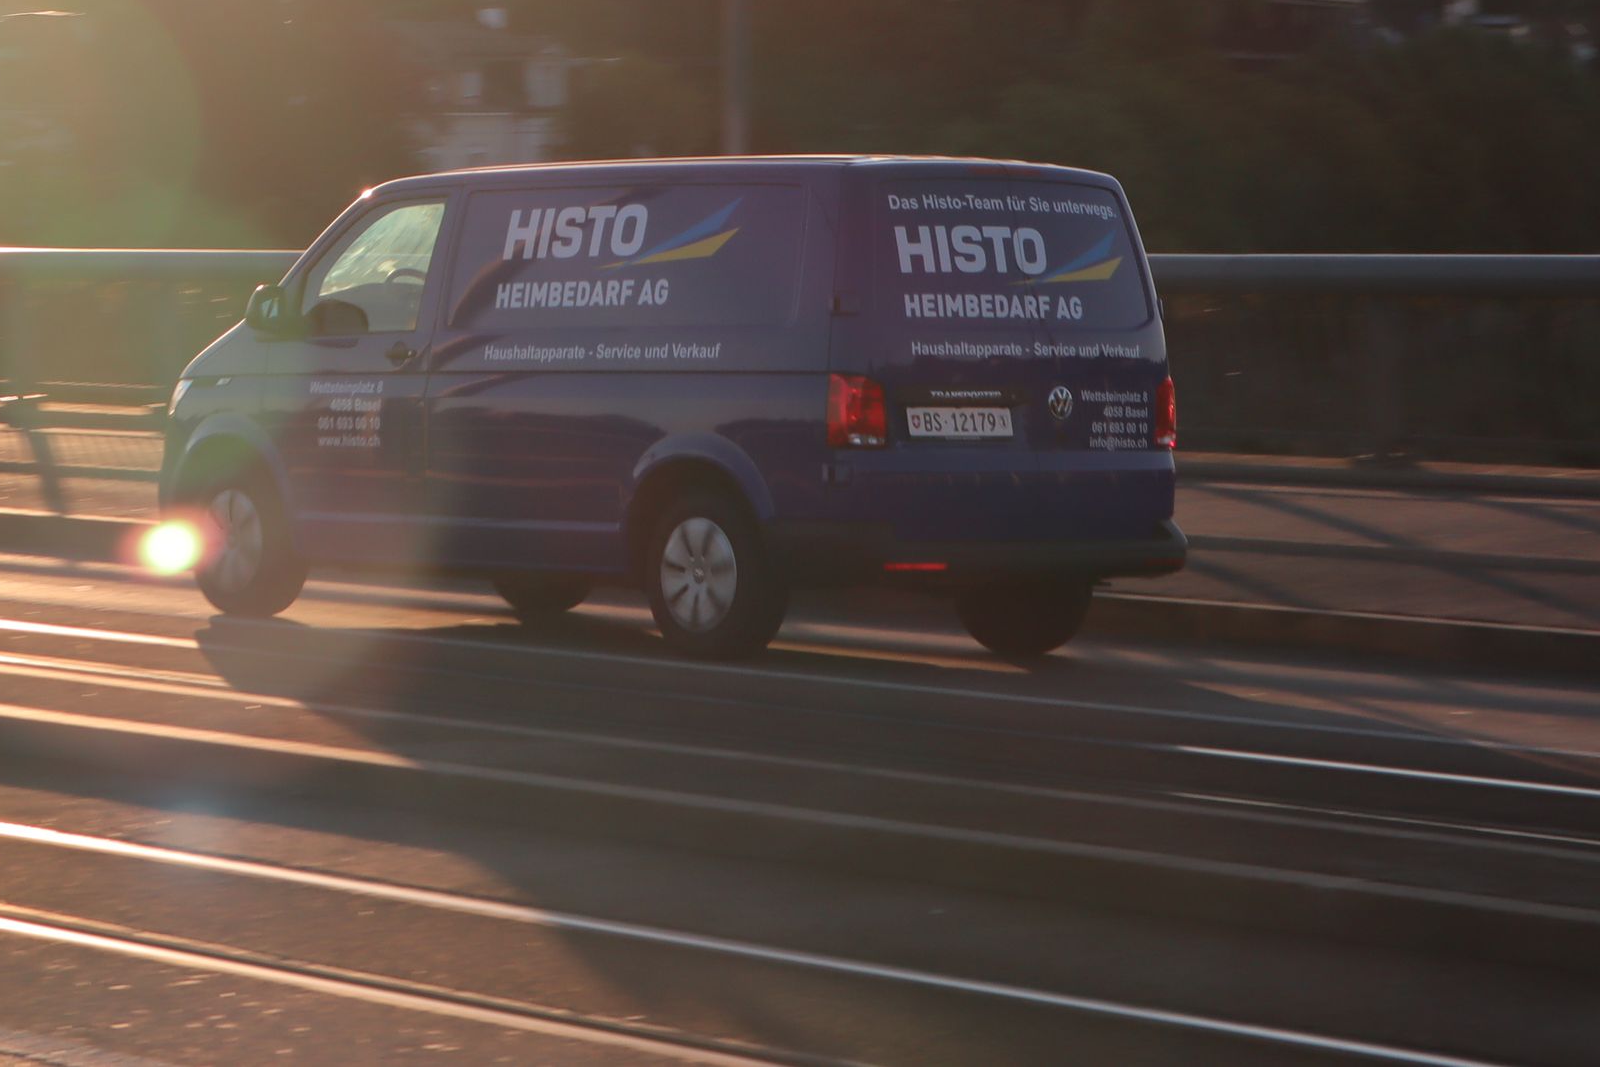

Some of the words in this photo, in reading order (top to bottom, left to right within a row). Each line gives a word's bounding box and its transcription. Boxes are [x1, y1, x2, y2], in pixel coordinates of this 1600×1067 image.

[888, 194, 918, 210] Das
[922, 194, 1003, 211] Histo-Team
[1007, 196, 1025, 212] für
[1029, 196, 1050, 213] Sie
[1053, 199, 1117, 221] unterwegs.
[502, 203, 649, 261] HISTO
[894, 225, 1048, 275] HISTO
[496, 279, 634, 309] HEIMBEDARF
[638, 279, 669, 306] AG
[903, 294, 1050, 319] HEIMBEDARF
[1056, 296, 1083, 320] AG
[483, 345, 586, 364] Haushaltapparate
[596, 343, 641, 359] Service
[644, 342, 670, 359] und
[672, 342, 721, 359] Verkauf
[911, 341, 1022, 359] Haushaltapparate
[1033, 341, 1076, 357] Service
[1078, 342, 1099, 358] und
[1102, 343, 1141, 359] Verkauf
[1125, 406, 1148, 419] Basel
